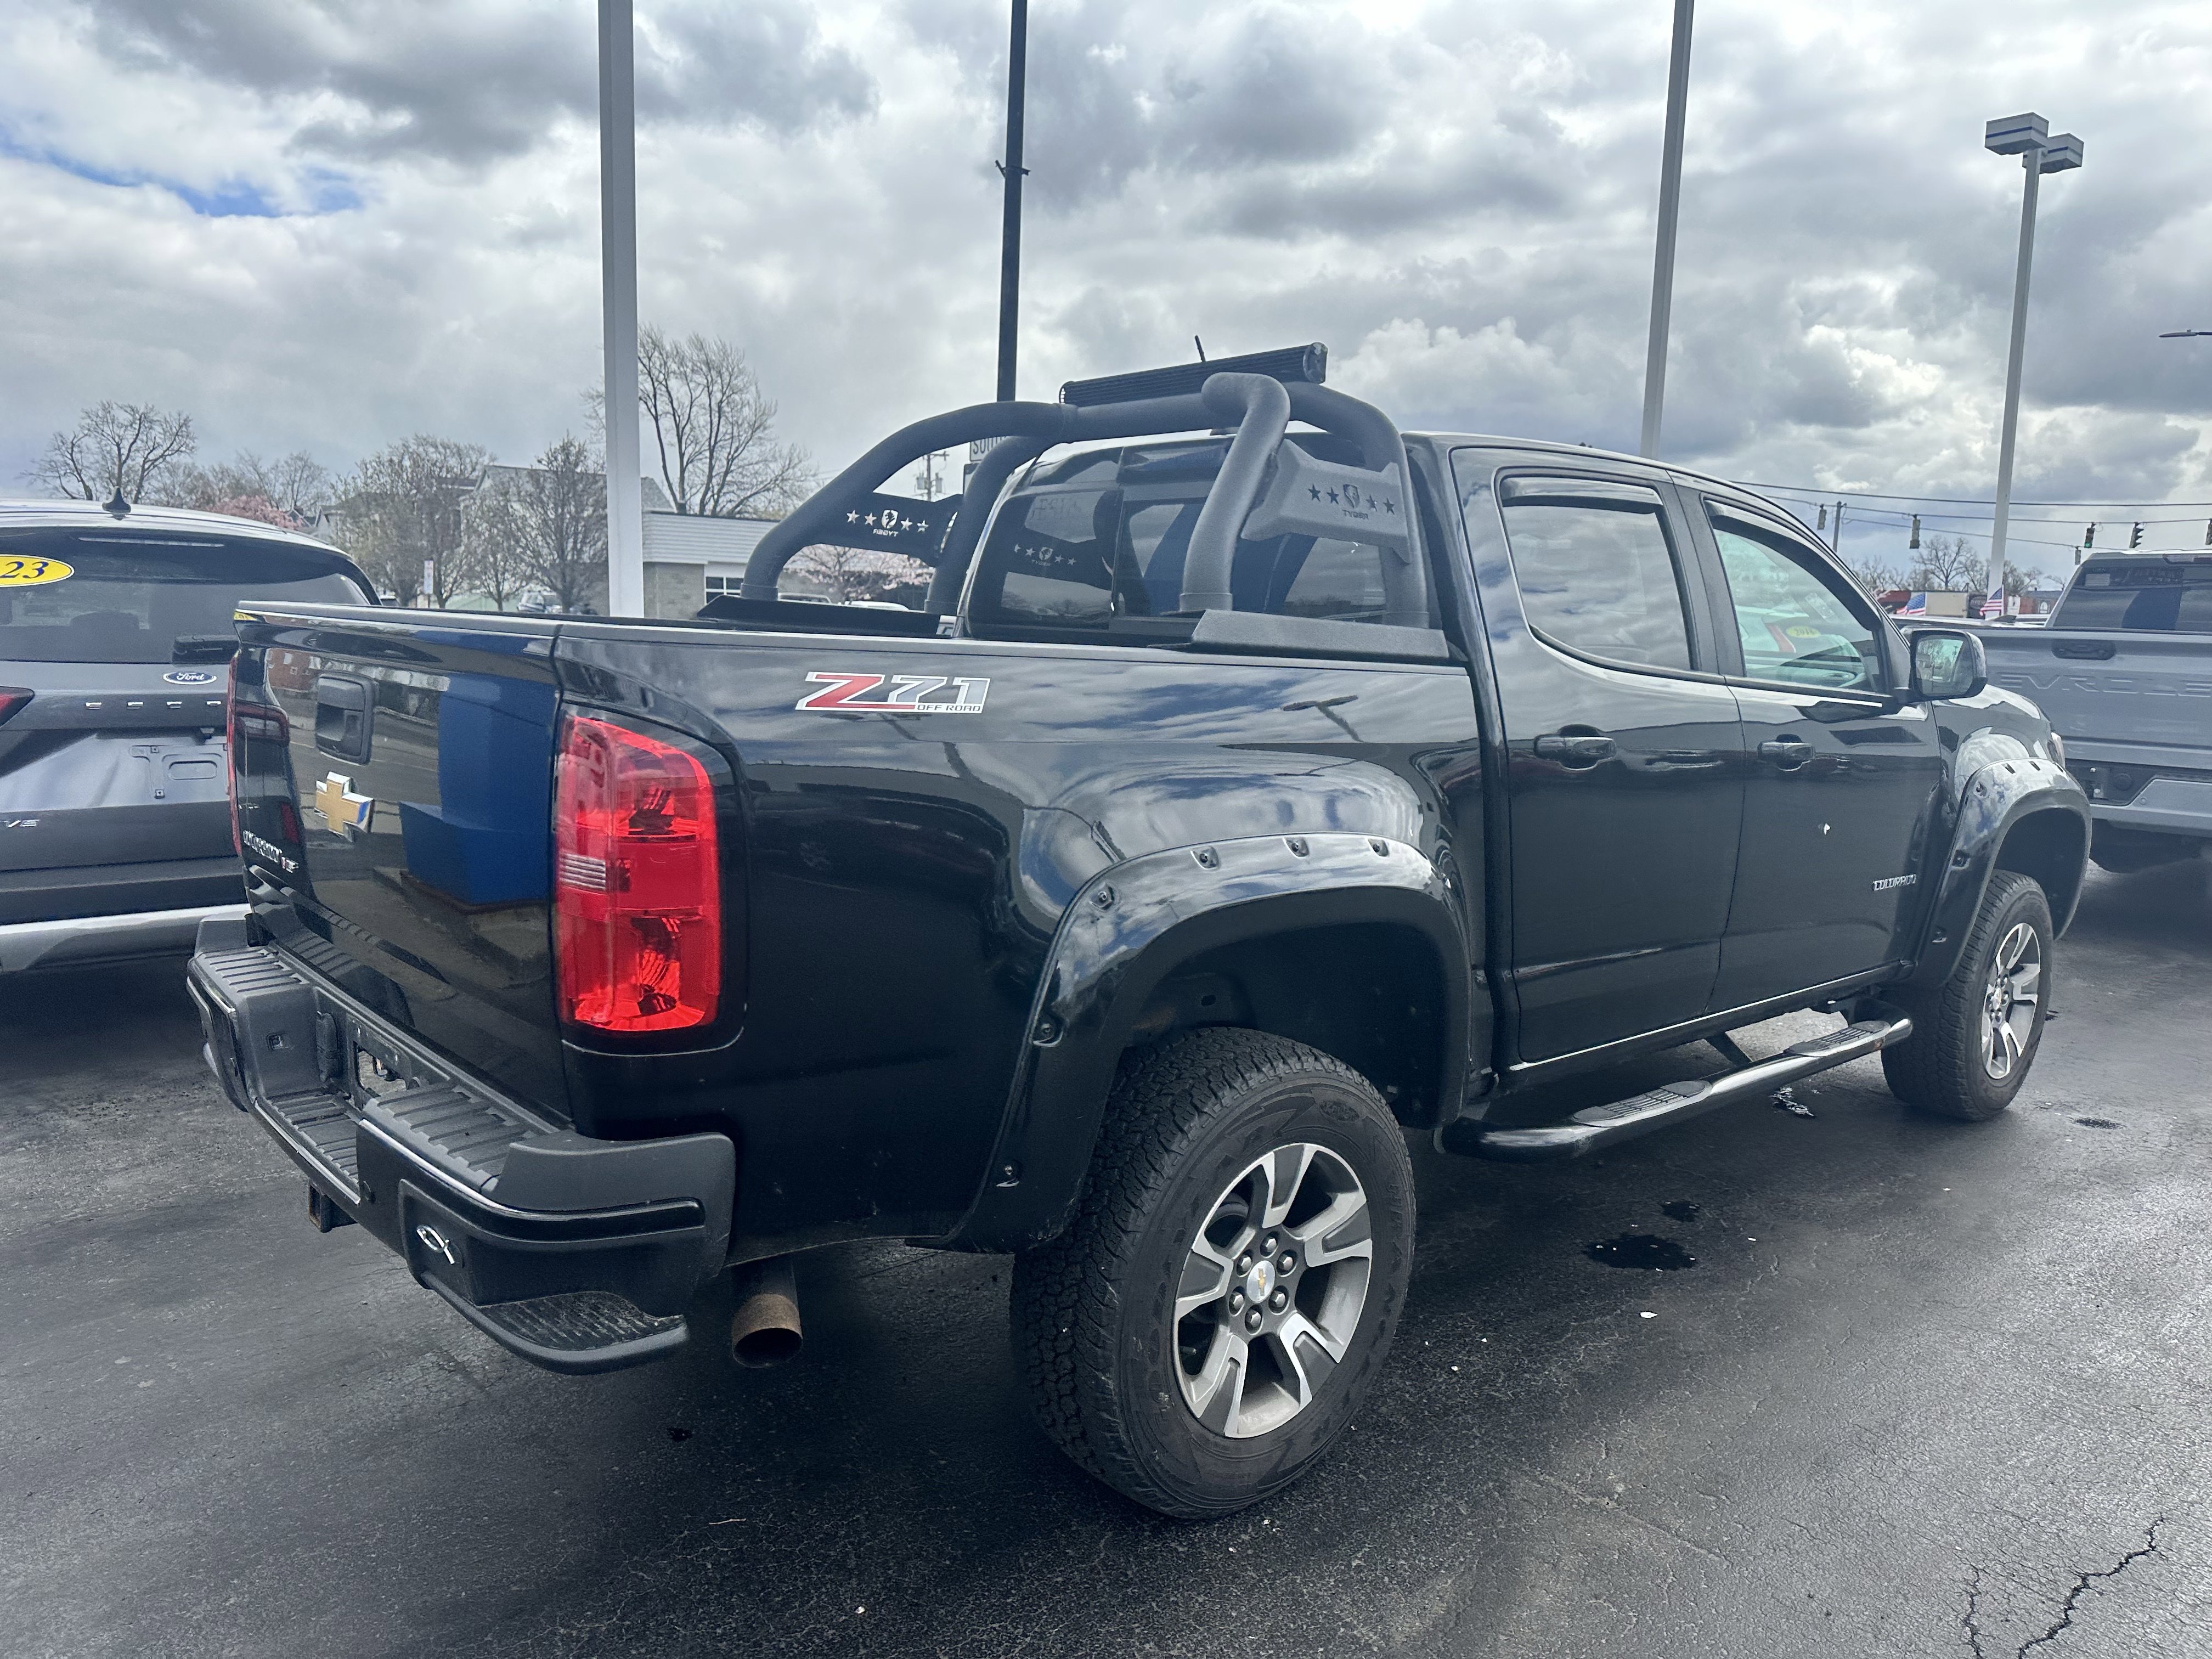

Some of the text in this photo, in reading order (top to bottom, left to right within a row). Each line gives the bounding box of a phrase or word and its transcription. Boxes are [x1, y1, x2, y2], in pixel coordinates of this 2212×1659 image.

[1342, 509, 1369, 520] TYGER
[176, 672, 205, 680] Ford
[795, 672, 991, 713] Z71
[1872, 873, 1917, 891] COLORADO
